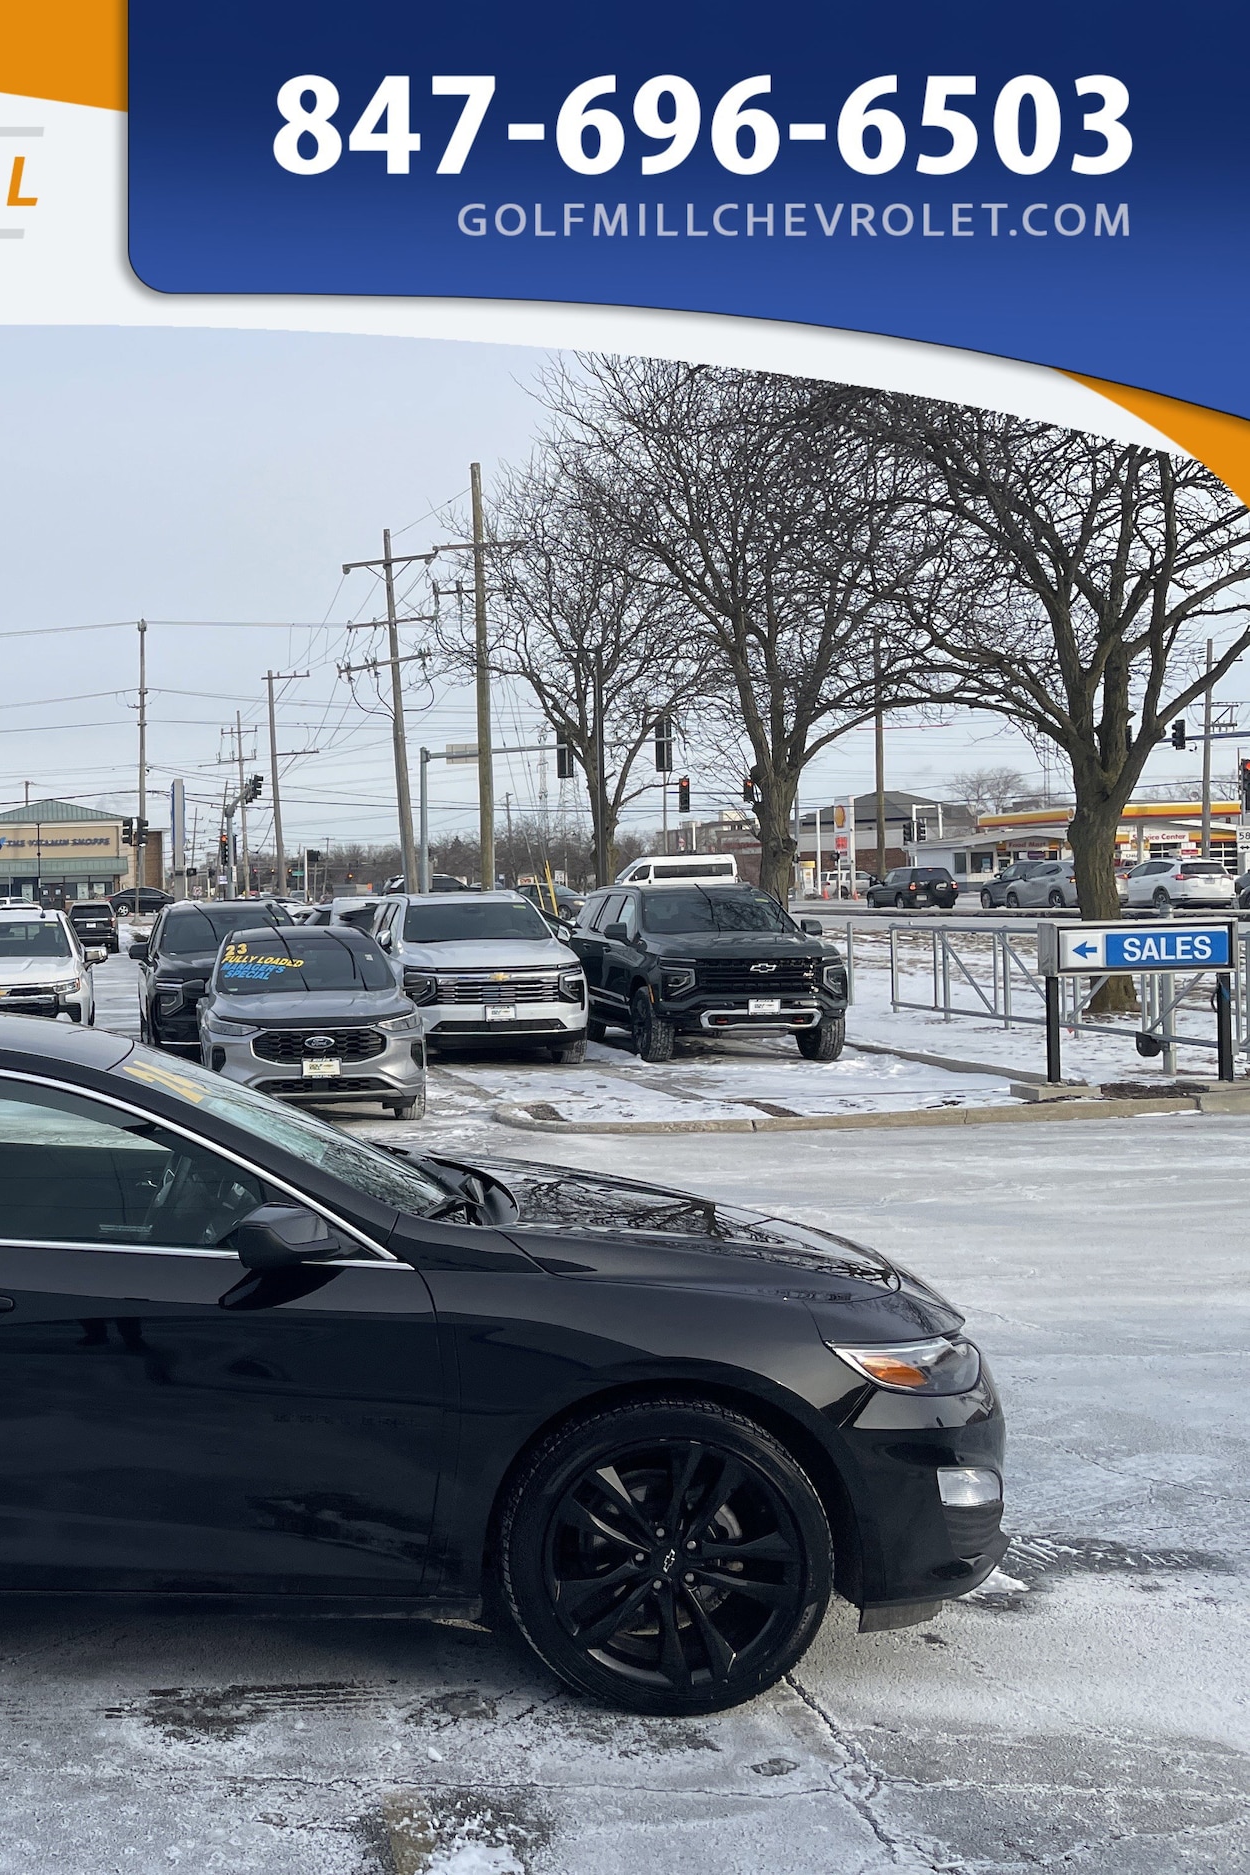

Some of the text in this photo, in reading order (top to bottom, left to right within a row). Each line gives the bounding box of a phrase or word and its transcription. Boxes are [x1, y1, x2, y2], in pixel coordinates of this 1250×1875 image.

[6, 837, 110, 848] THE VITAMIN SHOPPE
[1132, 833, 1186, 842] Svice Center
[225, 943, 248, 956] 23
[1122, 935, 1212, 962] SALES
[221, 955, 305, 968] FULLY LOADED
[221, 962, 286, 974] MANAGER'S
[224, 970, 270, 980] SPECIAL
